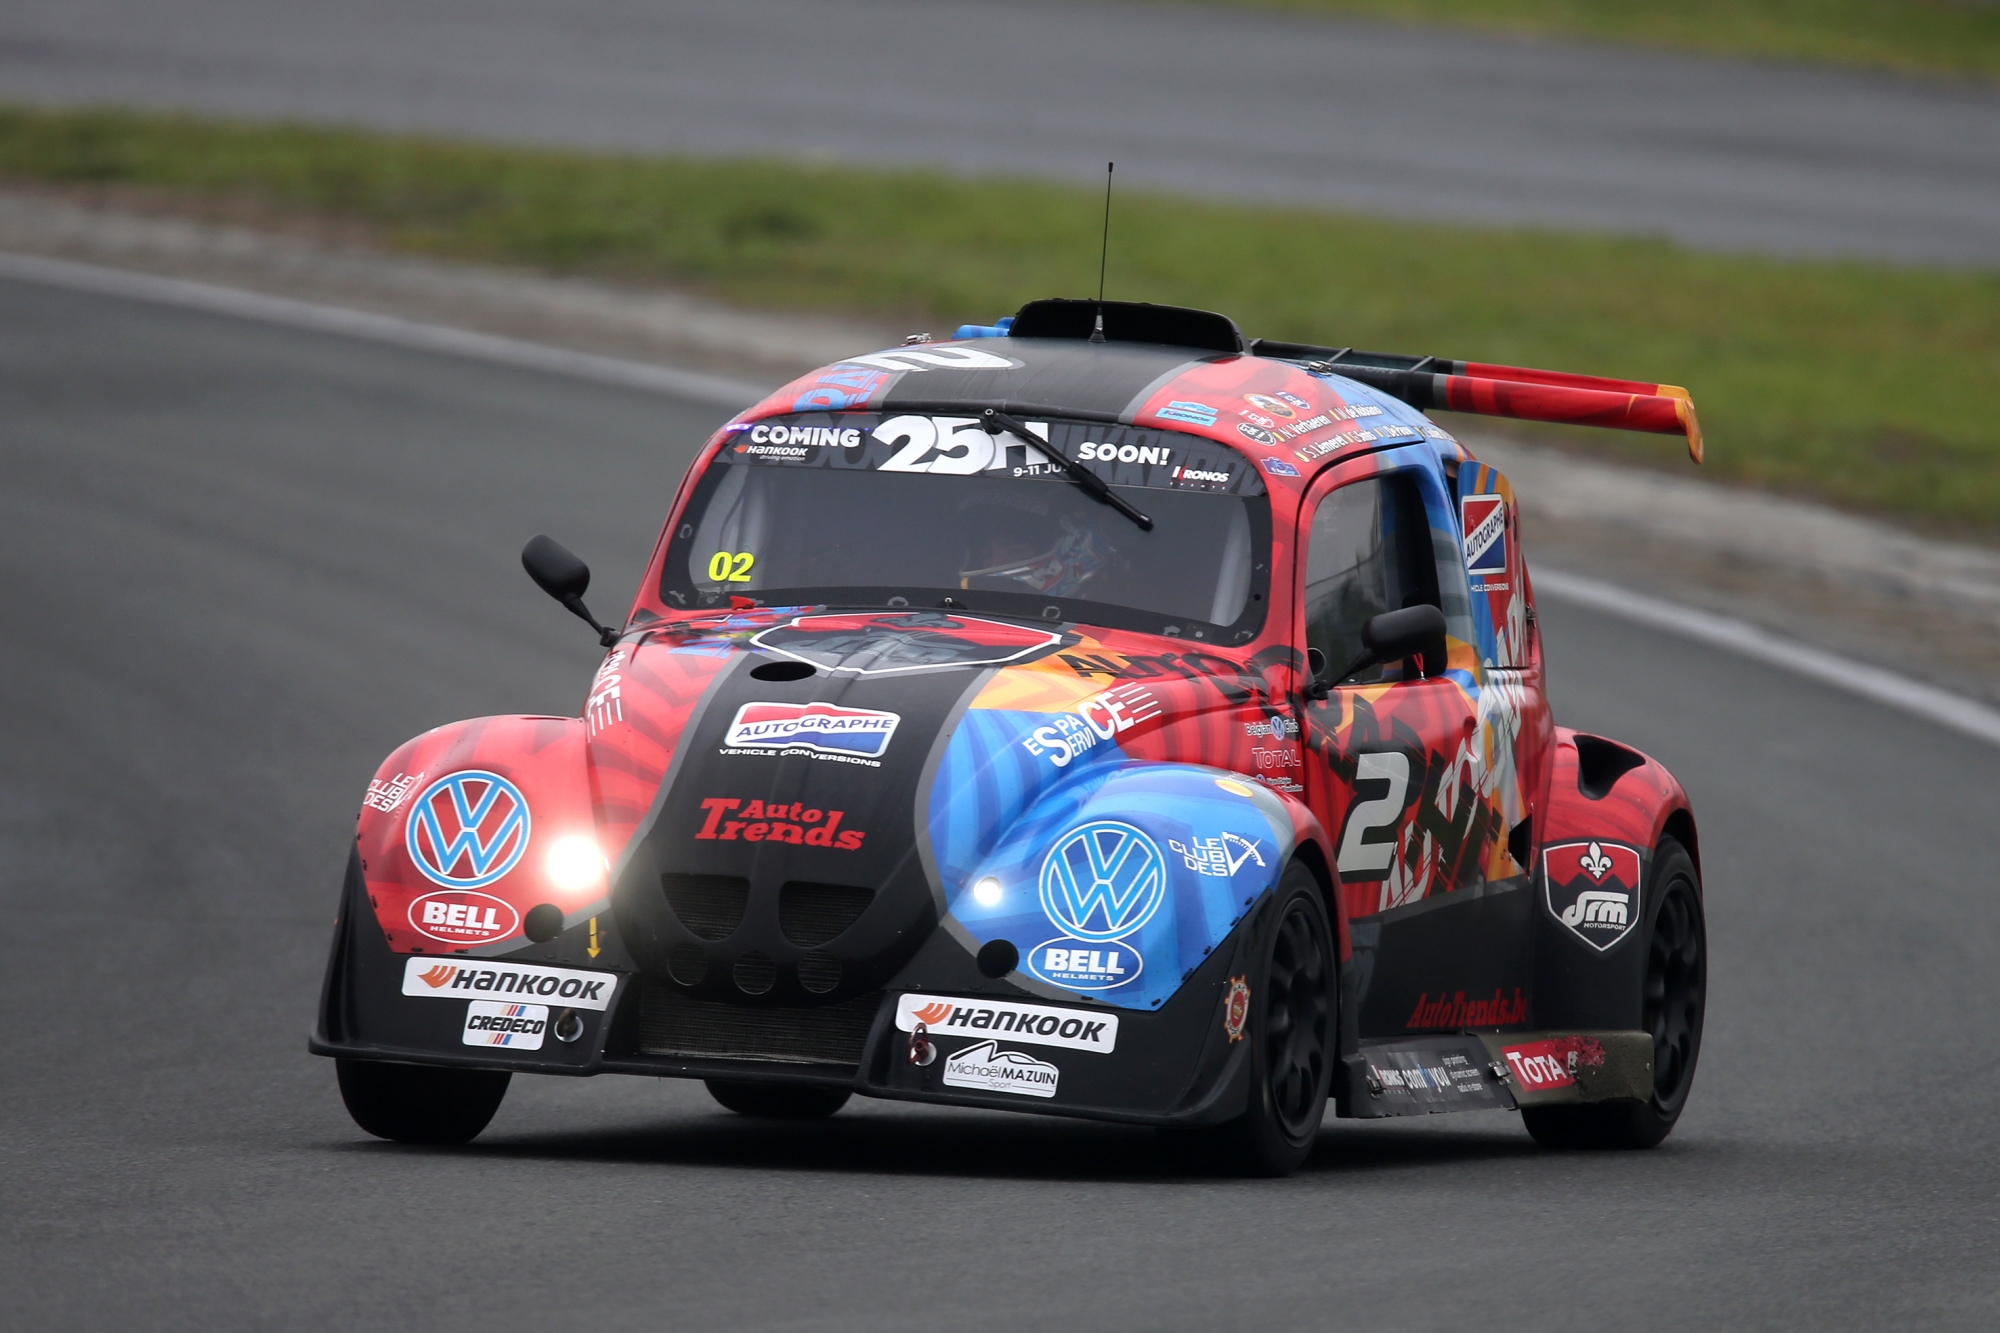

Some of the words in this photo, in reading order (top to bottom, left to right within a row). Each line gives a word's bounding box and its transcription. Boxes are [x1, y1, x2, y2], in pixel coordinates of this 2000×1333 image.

[750, 424, 861, 447] COMING
[1077, 442, 1171, 465] SOON!
[1013, 464, 1040, 477] 9-11
[1465, 508, 1504, 562] AUTOGRAPHE
[708, 551, 755, 583] 02
[736, 714, 893, 738] AUTOGRAPHE
[1244, 721, 1273, 739] Belgian
[1283, 719, 1300, 733] Club
[719, 747, 777, 758] VEHICLE
[780, 748, 882, 767] CONVERSIONS
[1251, 747, 1301, 769] TOTAL
[366, 779, 405, 800] CLUB
[390, 772, 416, 788] LE
[362, 792, 394, 813] DES
[744, 801, 824, 824] Auto
[1336, 751, 1410, 872] 2
[694, 797, 866, 851] Trends
[1168, 839, 1226, 864] CLUB
[1193, 836, 1222, 850] LE
[1185, 857, 1229, 877] DES
[422, 900, 501, 931] BELL
[429, 925, 490, 937] HELMETS
[1583, 922, 1627, 931] MOTORSPORT
[1044, 948, 1126, 976] BELL
[1051, 972, 1115, 982] HELMETS
[467, 1015, 546, 1035] CREDECO
[987, 1078, 1011, 1090] Sport
